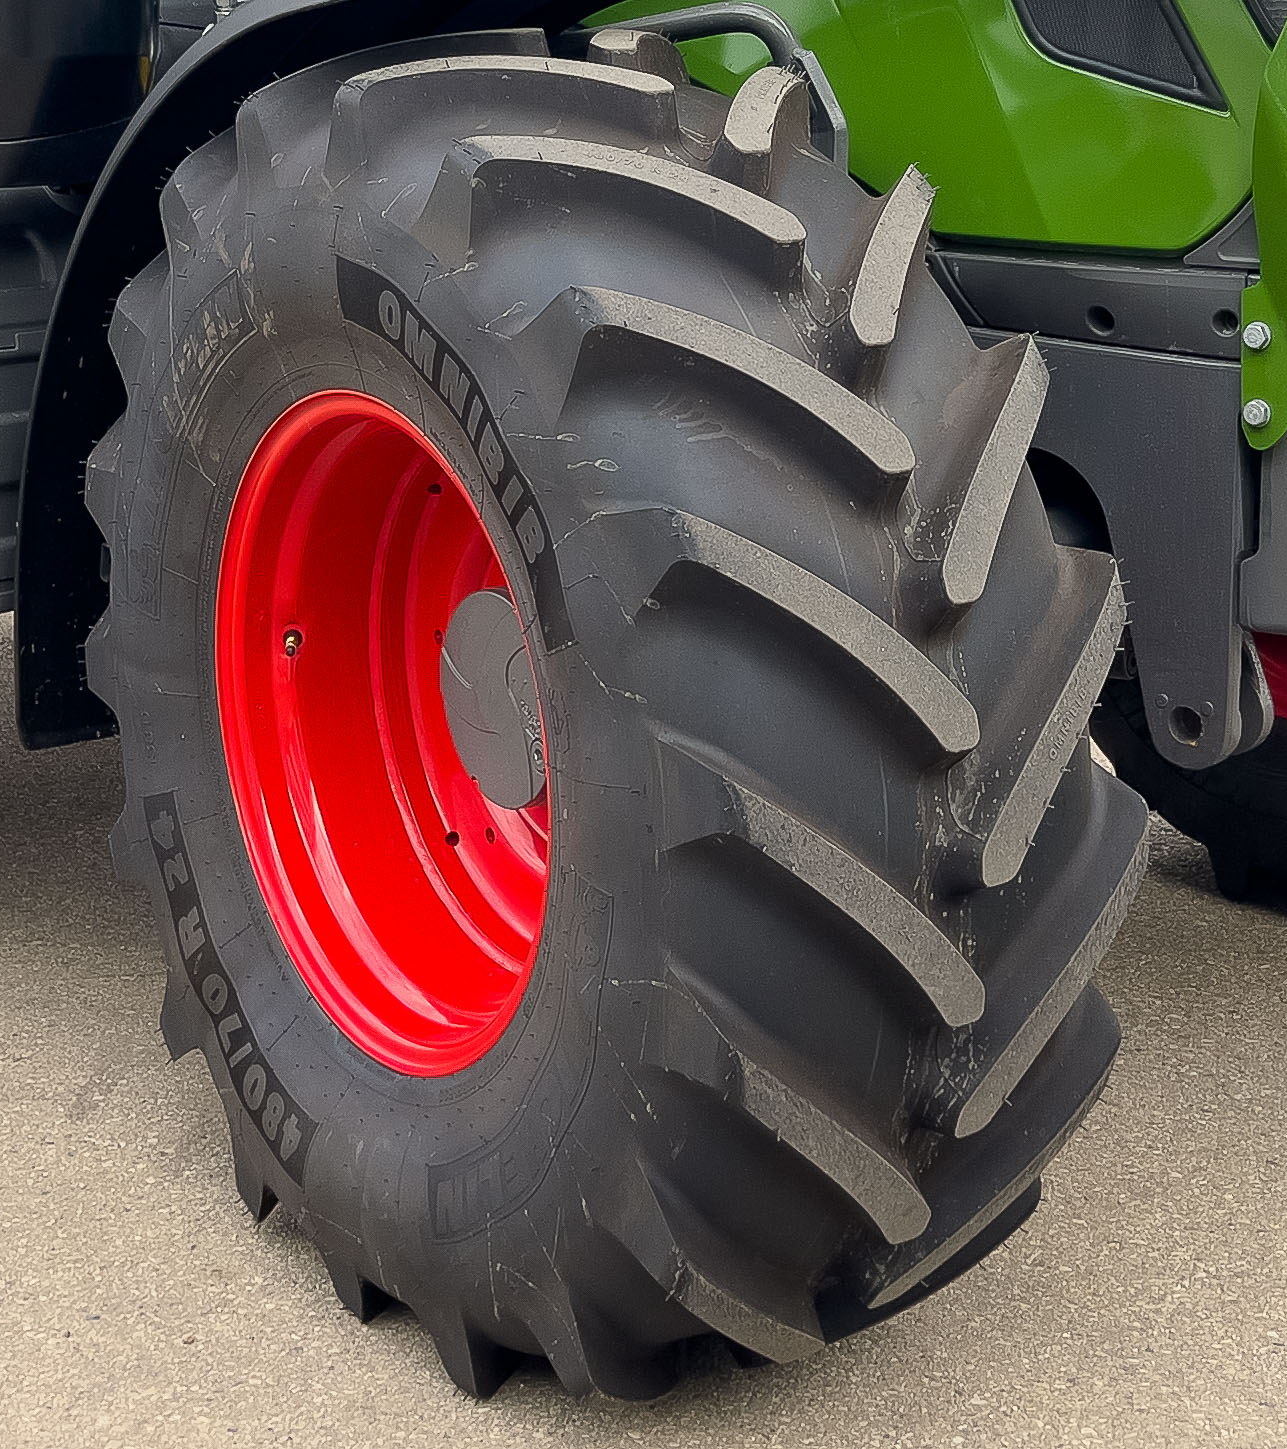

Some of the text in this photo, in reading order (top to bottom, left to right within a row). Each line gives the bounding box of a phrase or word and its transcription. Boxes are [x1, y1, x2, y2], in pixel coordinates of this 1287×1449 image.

[377, 289, 546, 565] OMNIBIB
[151, 810, 190, 892] 24
[179, 905, 208, 960] R
